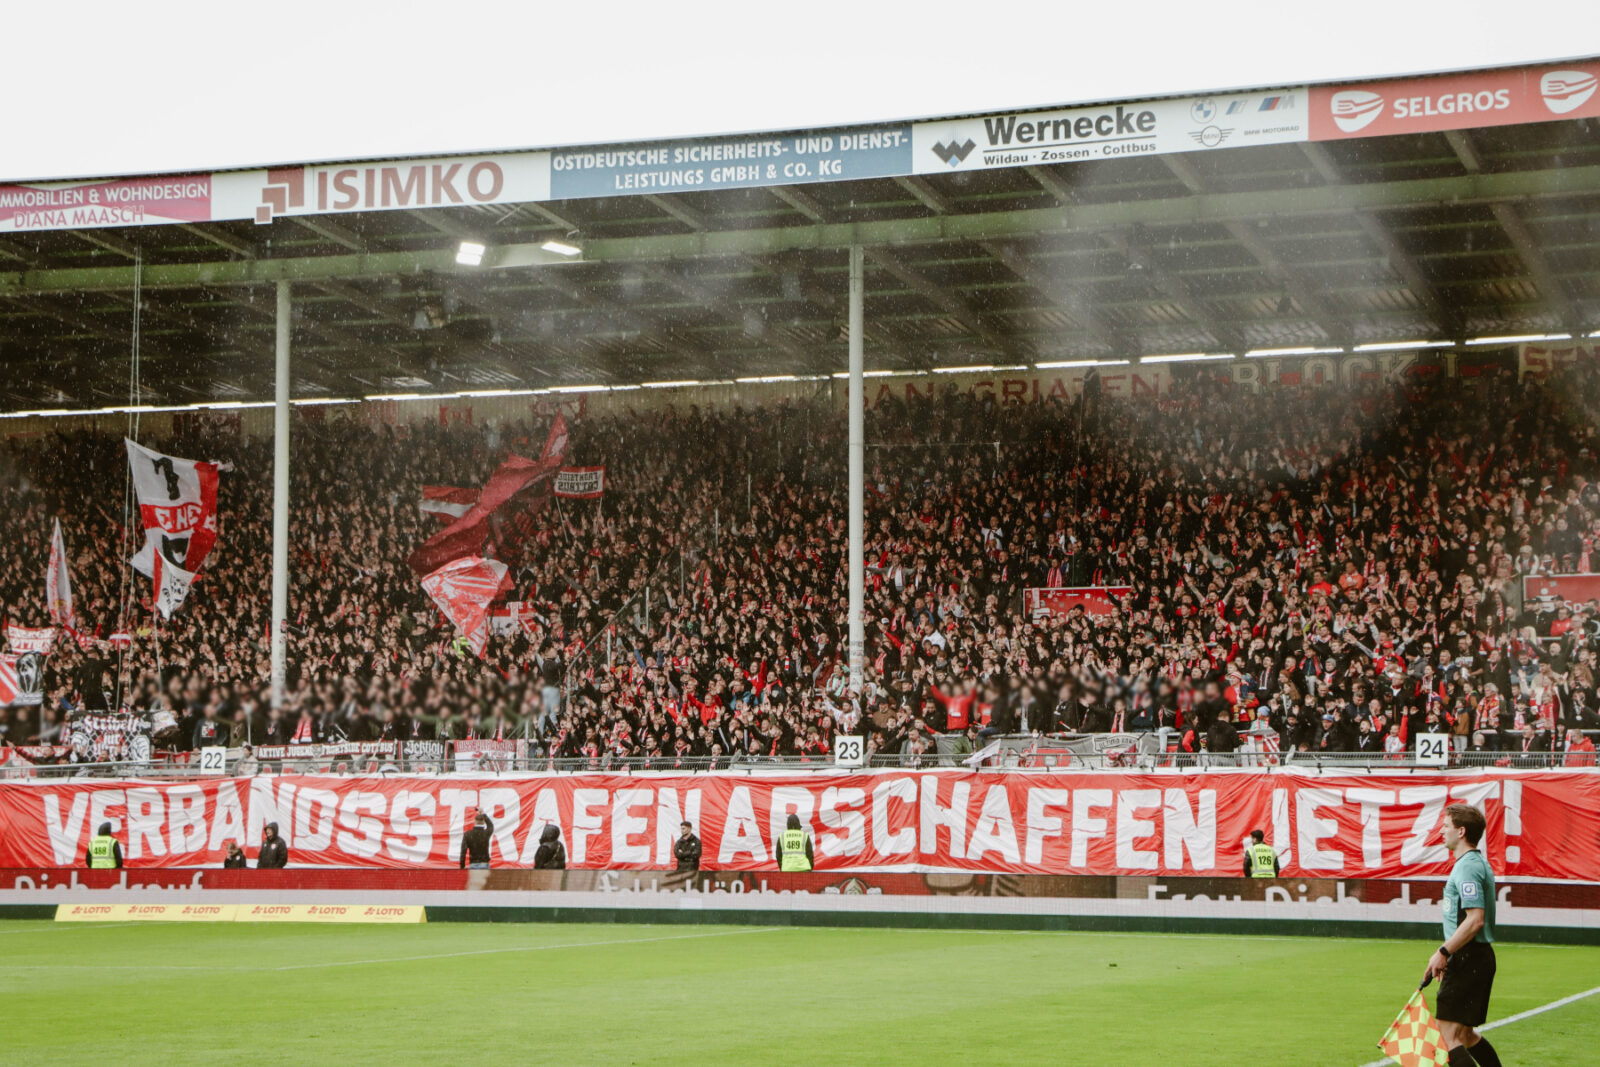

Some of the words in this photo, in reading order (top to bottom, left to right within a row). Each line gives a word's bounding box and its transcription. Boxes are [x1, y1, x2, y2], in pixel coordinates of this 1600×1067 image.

[1393, 89, 1510, 118] SELGROS
[983, 106, 1156, 146] Wernecke
[553, 149, 668, 172] OSTDEUTSCHE
[674, 140, 789, 165] SICHERHEITS-
[795, 136, 834, 155] UND
[839, 131, 909, 152] DIENST-
[984, 153, 1028, 166] Wildau
[1041, 148, 1090, 161] Zossen
[1102, 141, 1156, 155] Cottbus
[615, 169, 704, 190] LEISTUNGS
[710, 164, 760, 183] GMBH
[765, 163, 778, 179] &
[784, 162, 812, 178] CO.
[818, 159, 843, 176] KG
[88, 188, 100, 204] &
[105, 183, 208, 202] WOHNDESIGN
[317, 161, 505, 211] ISIMKO
[14, 208, 67, 228] DIANA
[76, 205, 145, 225] MAASCH
[838, 741, 860, 761] 23
[1419, 738, 1445, 759] 24
[203, 751, 223, 770] 22
[43, 777, 702, 866] VERBANDSSTRAFEN
[718, 775, 1217, 870] ABSCHAFFEN
[1242, 779, 1522, 869] JETZT!
[1258, 855, 1272, 865] 126
[83, 906, 112, 914] LOTTO
[138, 905, 167, 914] LOTTO
[193, 906, 221, 914] LOTTO
[263, 906, 292, 914] LOTTO
[318, 907, 347, 915] LOTTO
[375, 908, 405, 916] LOTTO
